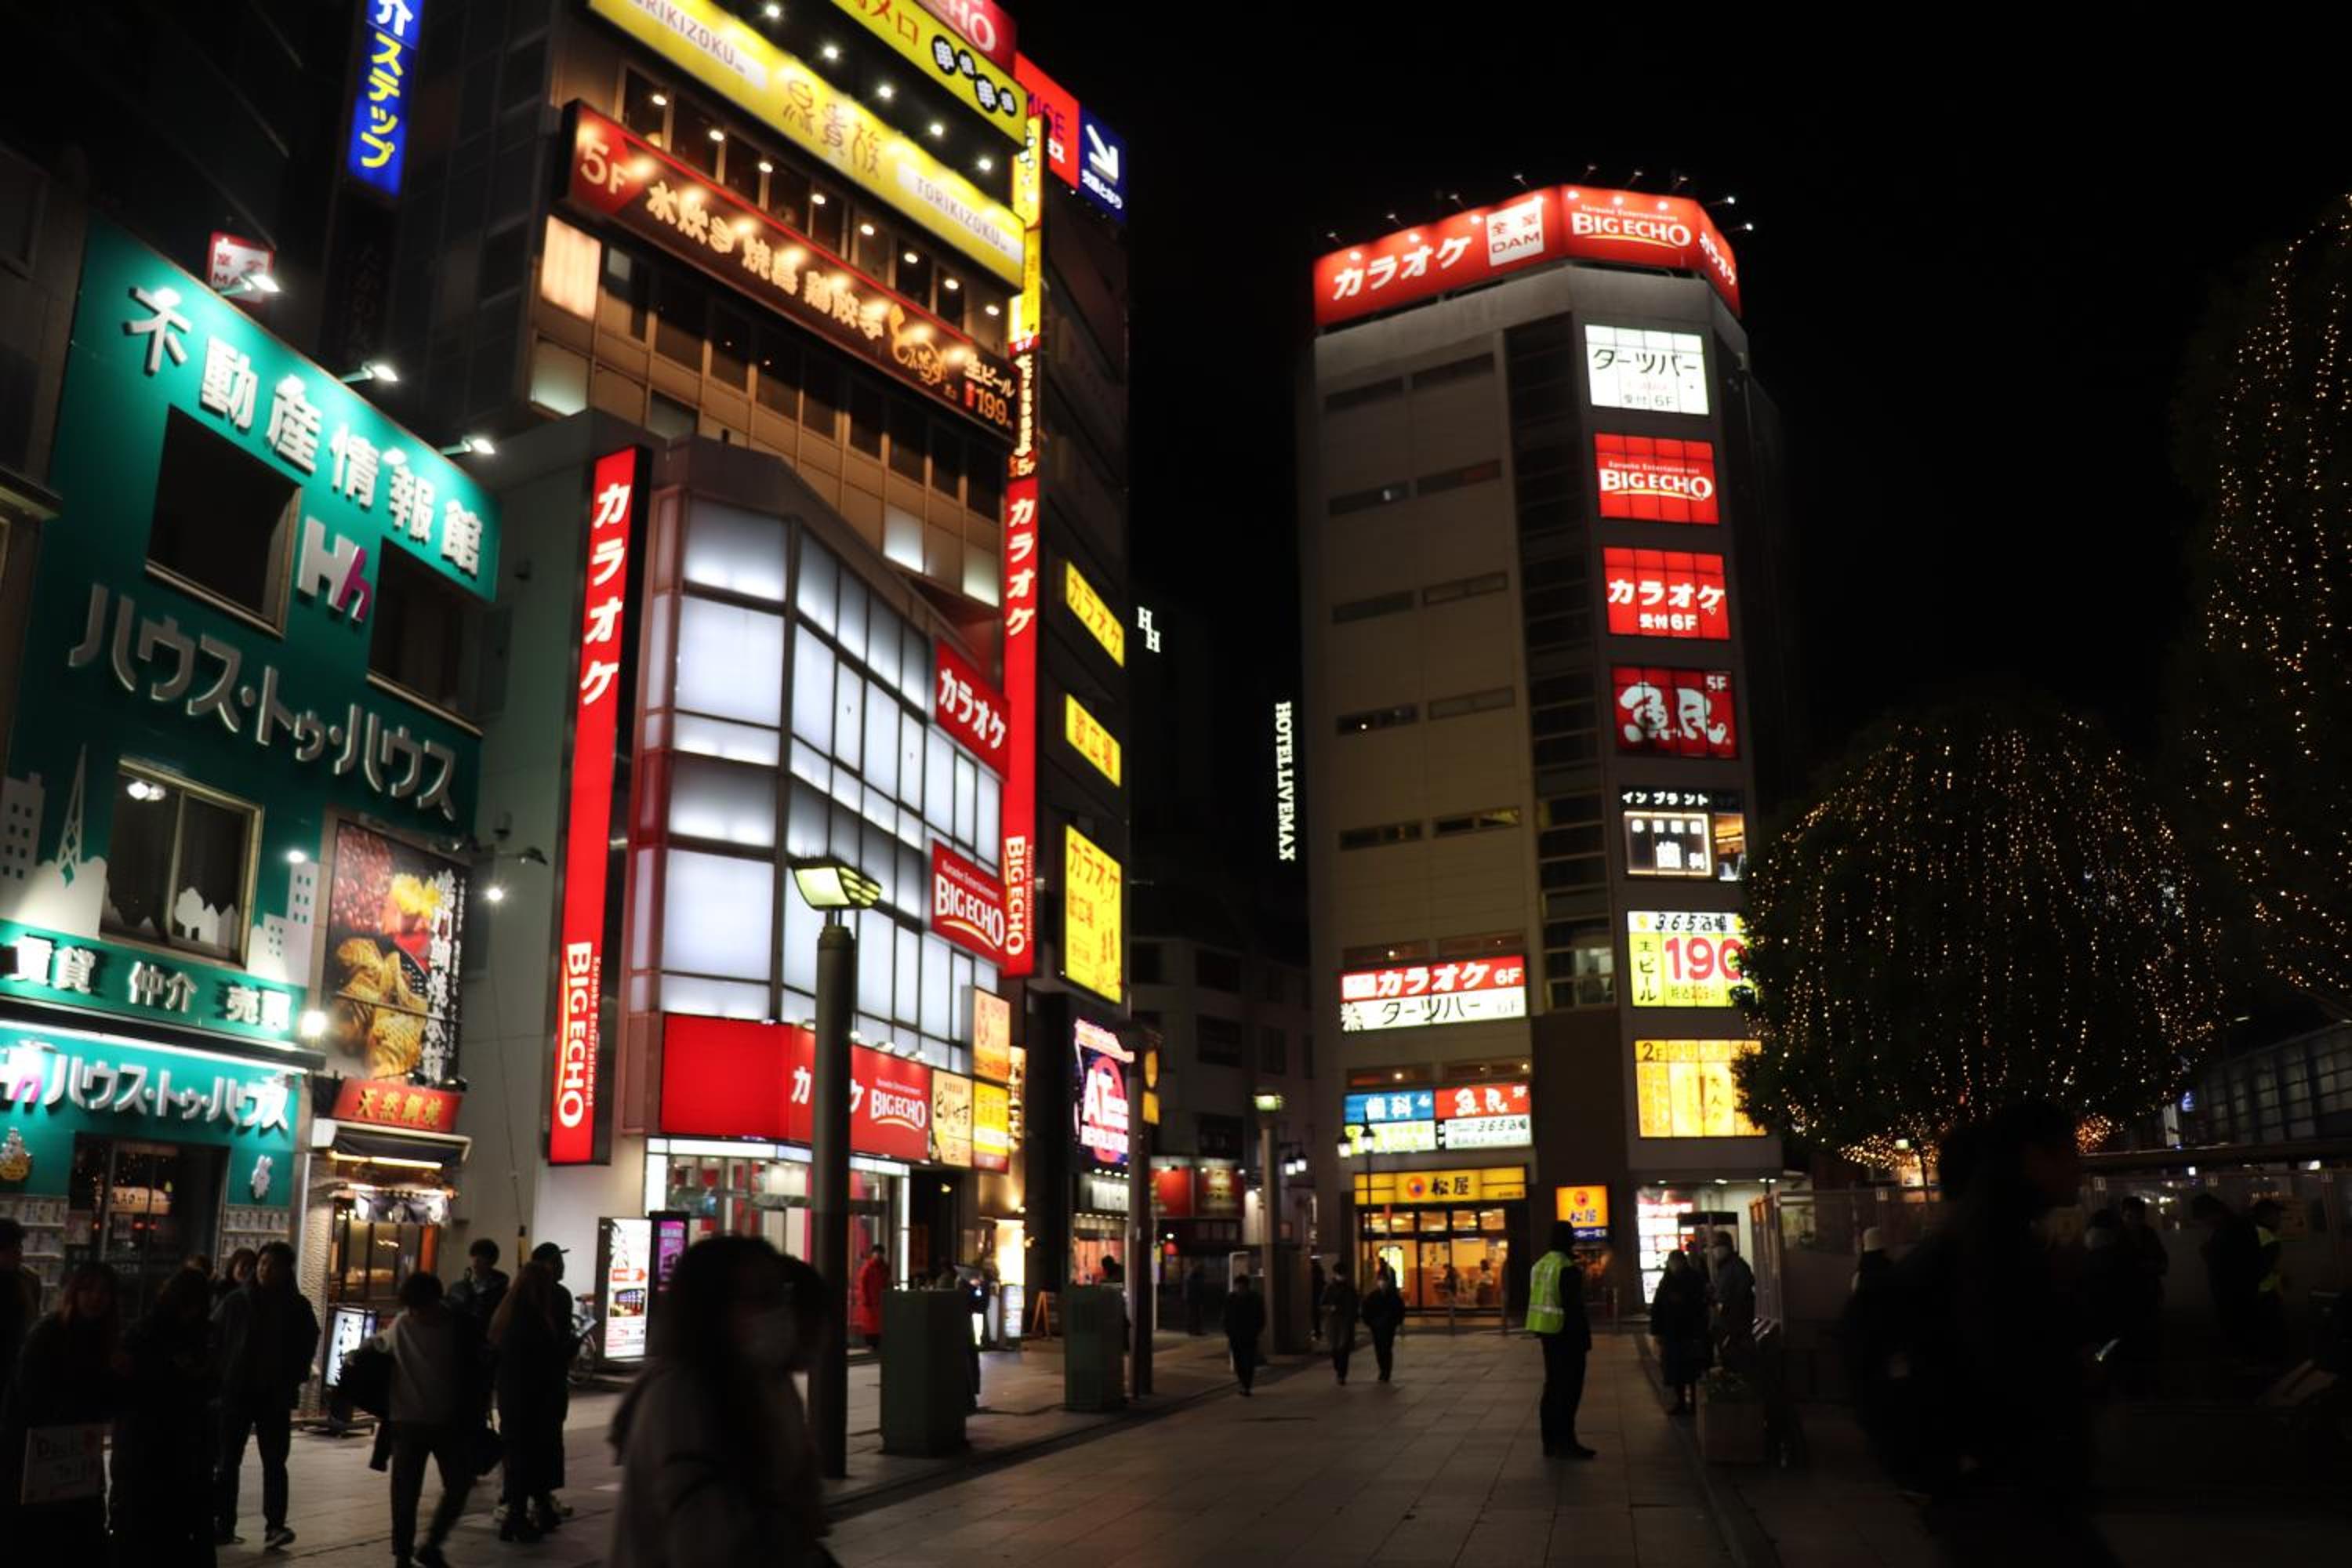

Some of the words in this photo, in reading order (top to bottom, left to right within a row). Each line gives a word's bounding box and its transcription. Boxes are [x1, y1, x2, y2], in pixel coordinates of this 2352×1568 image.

[581, 140, 628, 194] 5F
[916, 177, 1001, 245] TORIKIZOKU
[1492, 232, 1541, 253] DAM
[1571, 212, 1620, 235] BIG
[1622, 219, 1691, 247] ECHO
[1333, 237, 1472, 300] カラオケ
[123, 287, 483, 577] 不動産情報館
[1599, 468, 1646, 492] BIG
[1648, 474, 1713, 499] ECHO
[581, 483, 630, 705] カラオケ
[1007, 498, 1035, 637] カラオケ
[1608, 579, 1726, 610] カラオケ
[68, 582, 456, 822] ハウス・トゥ・ハウス
[939, 668, 1007, 750] カラオケ
[1619, 681, 1727, 745] 魚民
[1706, 674, 1727, 691] 5F
[1276, 701, 1294, 769] HOTEL
[1277, 769, 1296, 862] LIVEMAX
[1005, 836, 1025, 878] BIG
[935, 873, 965, 917] BIG
[965, 895, 1004, 947] ECHO
[1006, 887, 1025, 956] ECHO
[129, 961, 198, 1013] 仲介
[567, 942, 592, 1014] BIG
[1377, 961, 1490, 998] カラオケ
[1494, 967, 1523, 986] 6F
[43, 1053, 289, 1131] ハウス・トゥ・ハウス
[558, 1021, 586, 1127] ECHO
[870, 1089, 895, 1120] BIG
[895, 1097, 926, 1128] ECHO
[1431, 1175, 1469, 1196] 松屋
